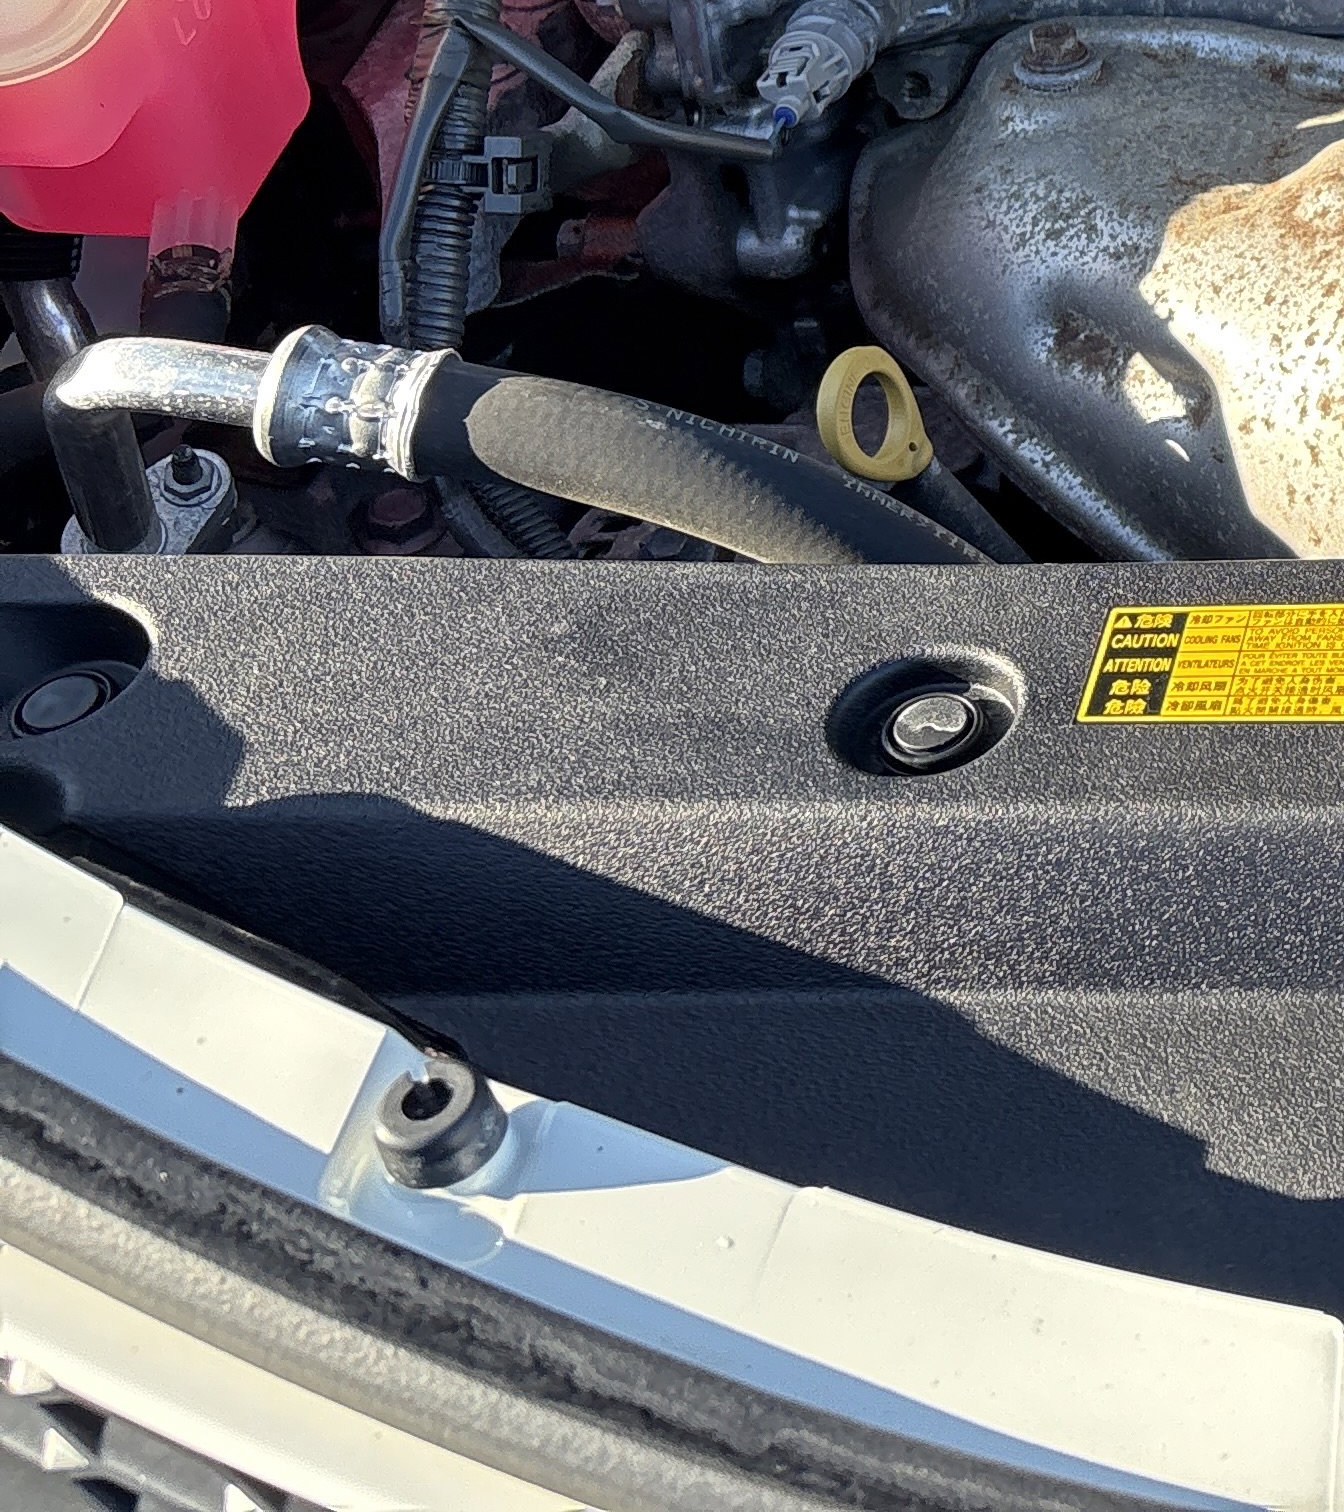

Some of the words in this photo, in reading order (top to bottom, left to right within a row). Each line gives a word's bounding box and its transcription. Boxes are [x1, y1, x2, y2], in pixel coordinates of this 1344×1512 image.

[1188, 614, 1247, 625] 冷却ファン
[1250, 627, 1264, 635] TO
[1267, 627, 1300, 635] AVOID
[1111, 633, 1180, 648] CAUTION
[1184, 635, 1219, 644] COOLING
[1220, 634, 1242, 644] FANS
[1247, 635, 1277, 643] AWAY
[1280, 634, 1312, 642] FROM
[1275, 641, 1322, 649] IGNITION
[1325, 641, 1336, 649] IS
[1103, 657, 1173, 673] ATTENTION
[1177, 659, 1236, 669] VENTILATEURS
[1108, 678, 1152, 696] 危险
[1171, 681, 1228, 692] 冷却风扇
